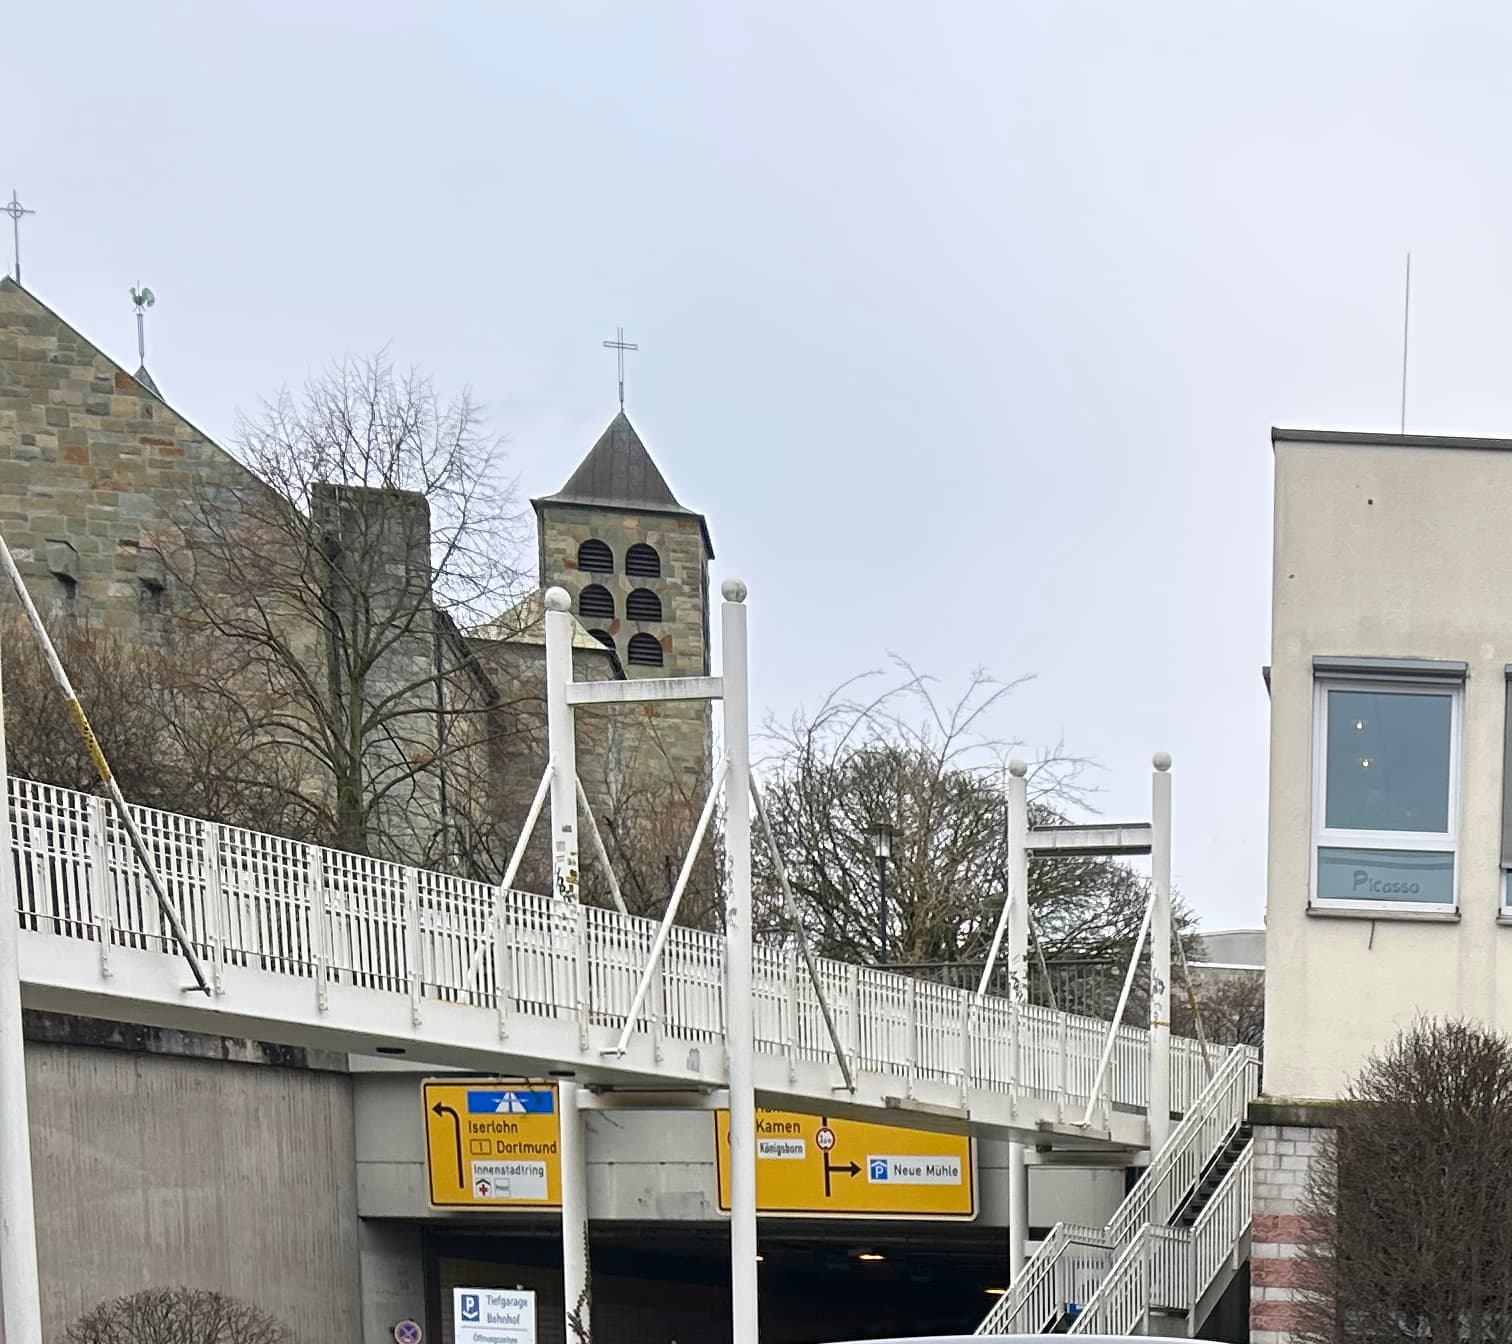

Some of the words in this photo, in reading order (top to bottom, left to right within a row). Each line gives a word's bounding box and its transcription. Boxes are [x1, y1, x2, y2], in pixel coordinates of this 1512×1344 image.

[1353, 869, 1420, 894] Picasso
[468, 1120, 518, 1134] Iserlohn
[756, 1118, 801, 1134] Kamen
[496, 1140, 557, 1154] Dortmund
[759, 1141, 804, 1158] Königsborn
[474, 1164, 544, 1178] Innenstadtring
[893, 1164, 922, 1177] Neue
[926, 1163, 959, 1178] Mühle
[486, 1295, 528, 1310] Tiefgarage
[487, 1313, 521, 1326] Bahnhof
